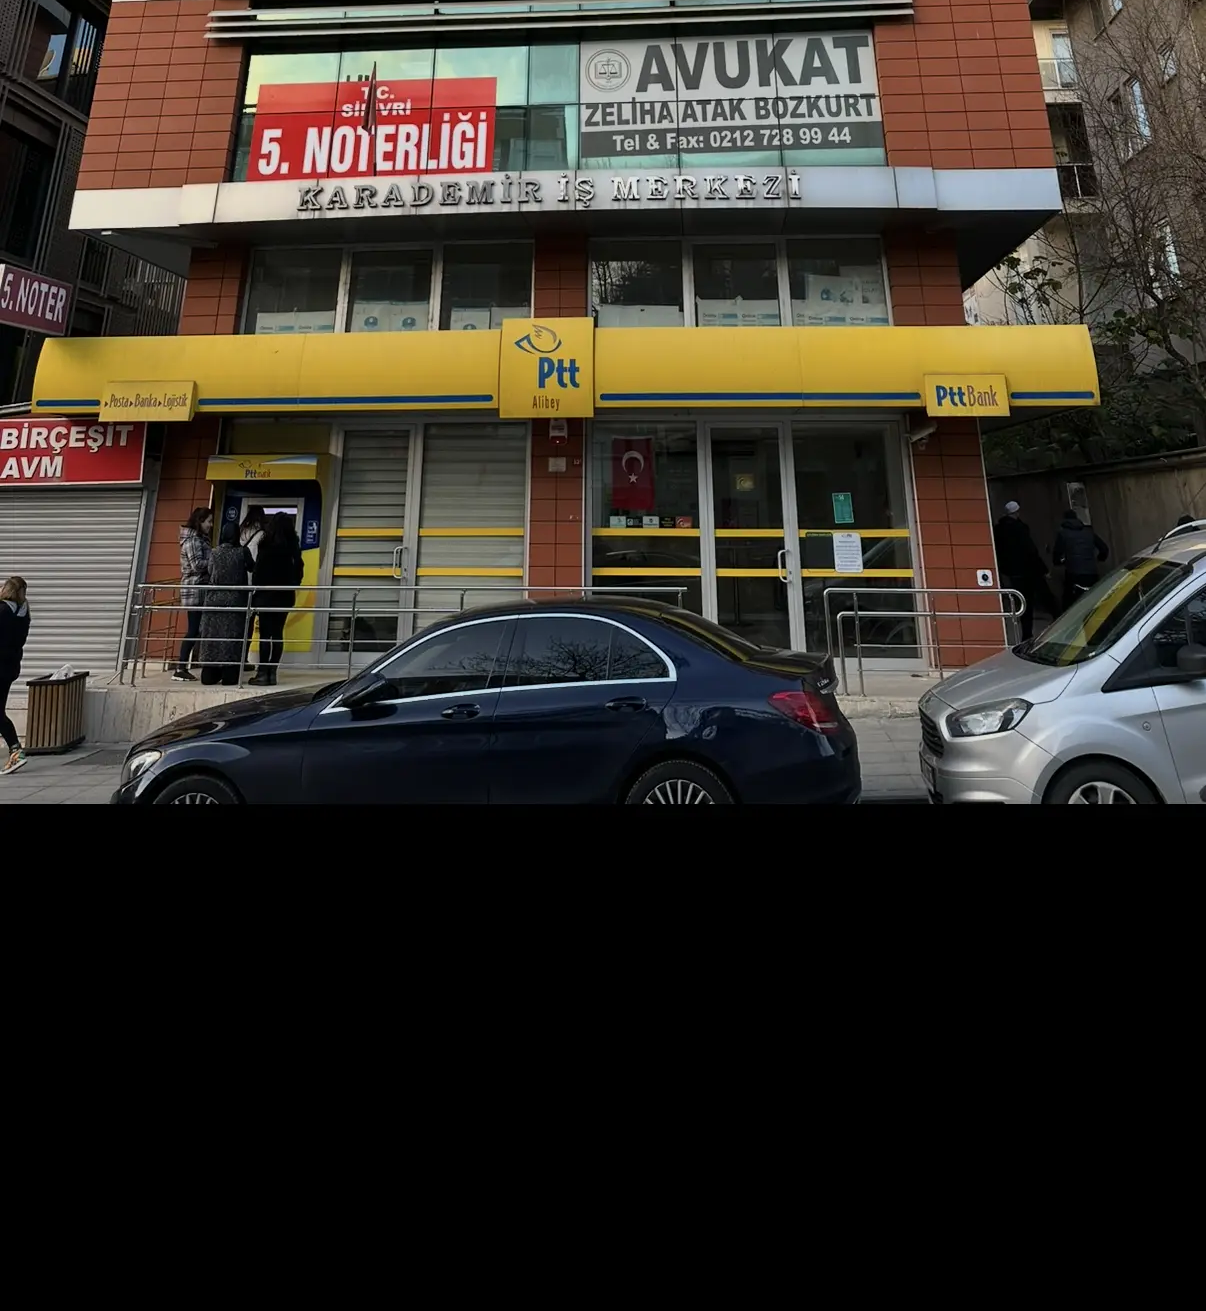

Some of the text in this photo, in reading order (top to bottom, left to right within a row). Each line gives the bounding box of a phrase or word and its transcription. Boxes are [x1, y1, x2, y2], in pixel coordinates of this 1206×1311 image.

[635, 35, 870, 93] AVUKAT
[341, 99, 412, 117] SİVRİ
[361, 86, 395, 99] TC.
[584, 93, 876, 127] ZELİHA ATAK BOZKURT
[257, 112, 487, 175] 5. NOTERLİĞİ
[613, 126, 852, 151] Tel & Fax: 0212 728 99 44
[297, 169, 802, 211] KARADEMİR İŞ MERKEZİ
[1, 273, 67, 323] 5. NOTER
[538, 356, 580, 389] Ptt
[109, 393, 189, 410] Posta Banka Lojistik
[532, 395, 560, 411] Alibey
[0, 422, 134, 454] BİRÇEŞİT
[0, 455, 64, 479] AVM
